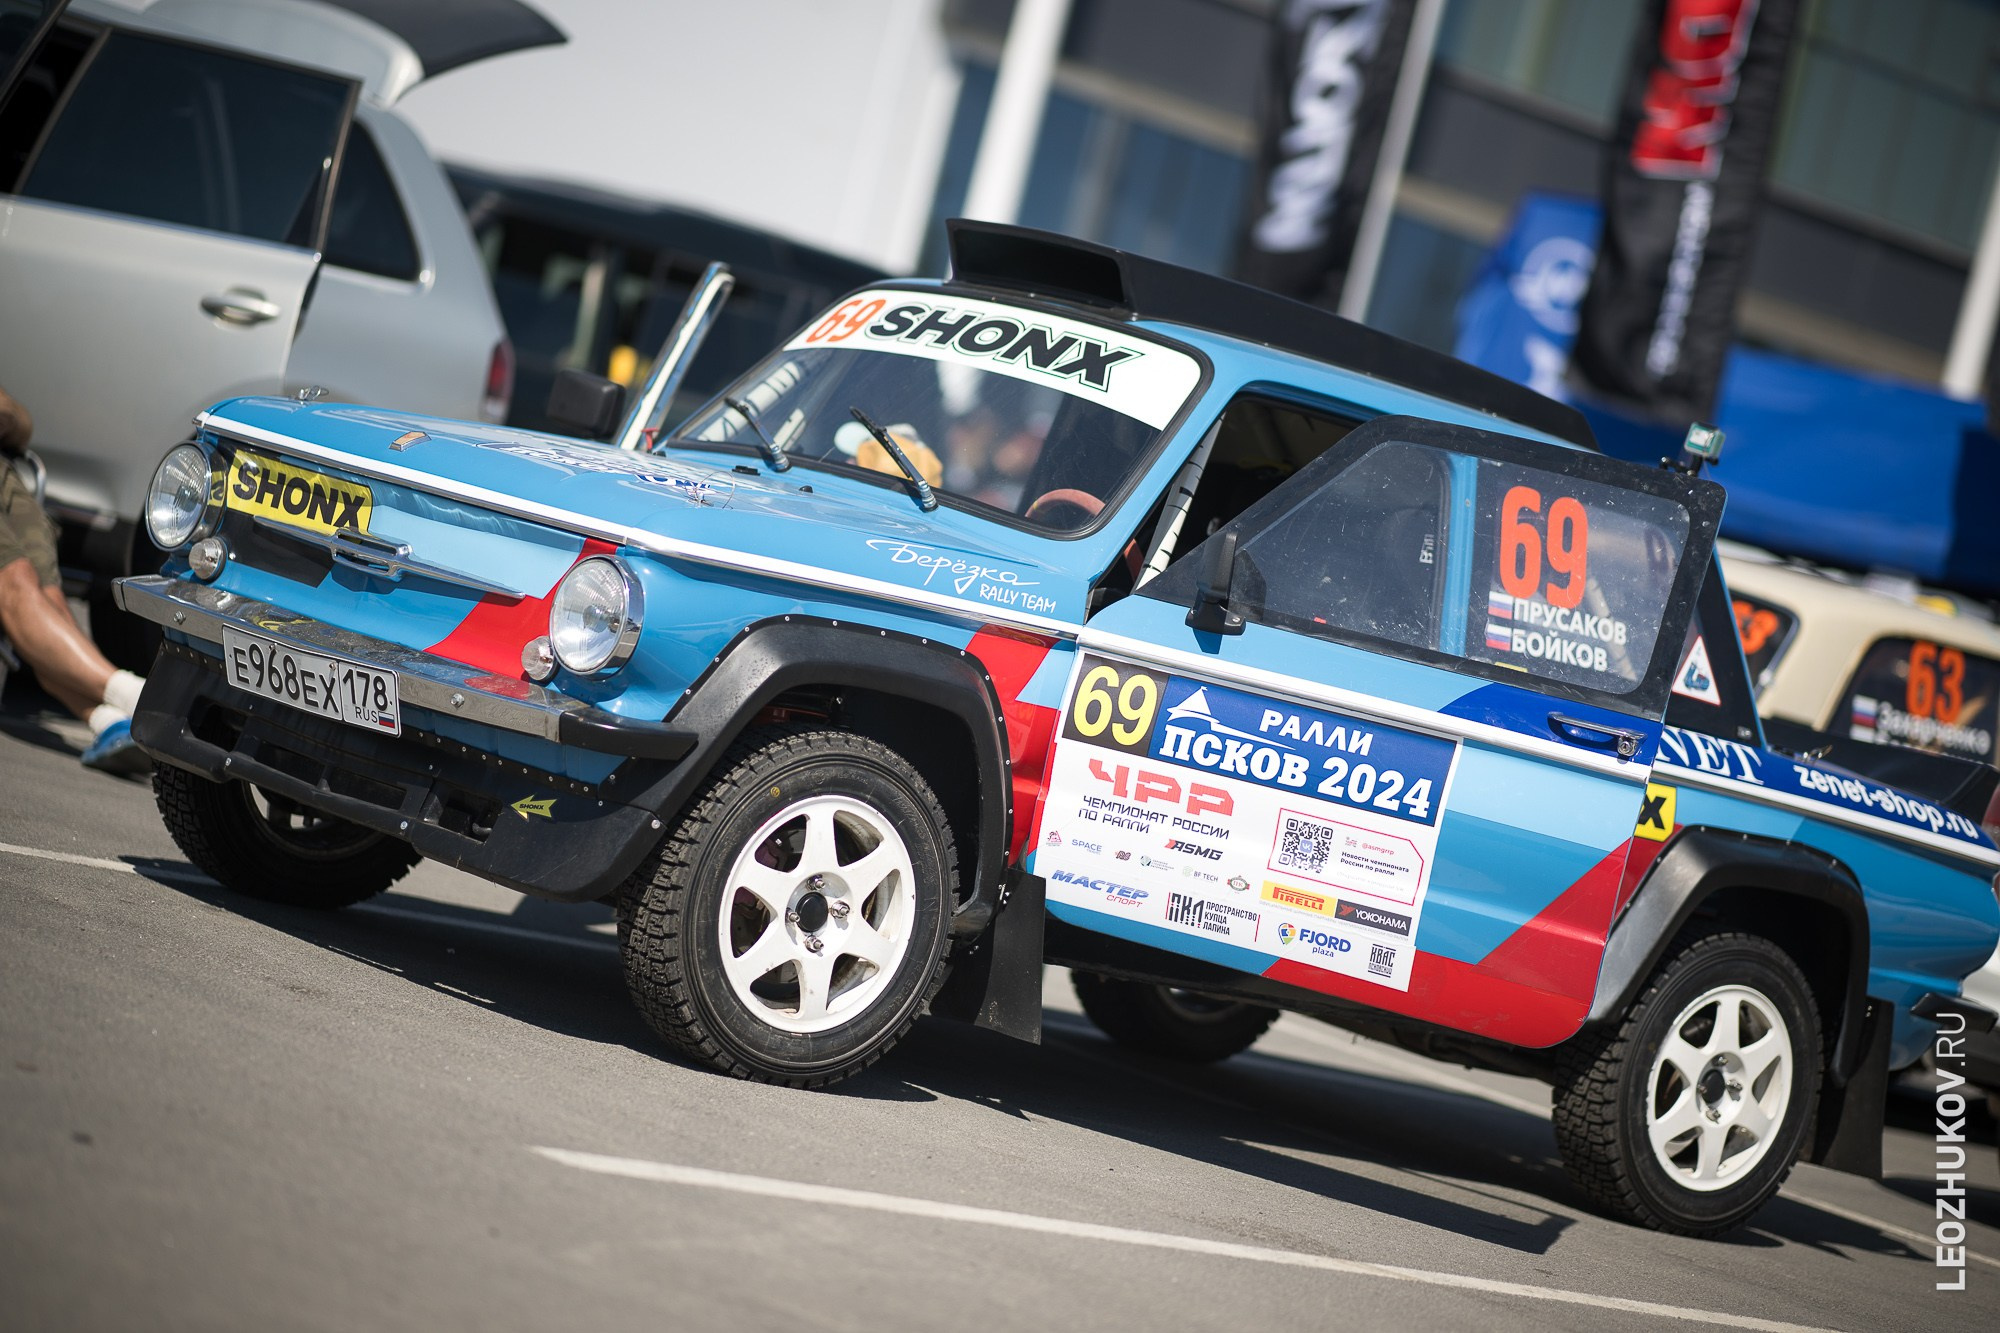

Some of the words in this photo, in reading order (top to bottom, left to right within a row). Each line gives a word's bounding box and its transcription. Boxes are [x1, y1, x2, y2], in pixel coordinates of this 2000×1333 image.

[806, 299, 887, 343] 69
[866, 303, 1143, 391] SHONX
[232, 462, 366, 529] SHONX
[1500, 486, 1588, 609] 69
[866, 539, 1041, 594] Берёзка
[979, 583, 1020, 605] RALLY
[1021, 592, 1057, 613] TEAM
[1513, 598, 1627, 646] ПРУСАКОВ
[1512, 629, 1608, 672] БОЙКОВ
[342, 668, 388, 711] 178
[1907, 640, 1965, 724] 63
[355, 706, 378, 724] RUS
[1073, 665, 1158, 746] 69
[1259, 708, 1373, 757] РАЛЛИ
[1159, 724, 1310, 788] ПСКОВ
[1317, 757, 1433, 818] 2024
[1088, 758, 1235, 817] ЧРР
[1792, 764, 1980, 839] zenet-shop.ru
[1079, 808, 1098, 822] ПО
[1102, 813, 1150, 834] РАЛЛИ
[1083, 795, 1168, 825] ЧЕМПИОНАТ
[1172, 816, 1230, 840] РОССИИ
[1072, 839, 1102, 852] SPACE
[1172, 840, 1223, 861] ASMG
[1340, 858, 1364, 870] России
[1374, 867, 1395, 877] ралли
[1341, 851, 1369, 863] Новости
[1369, 859, 1410, 873] чемпионата
[1051, 869, 1150, 900] МАСТЕР
[1202, 873, 1219, 883] TECH
[1106, 894, 1143, 908] СПОРТ
[1205, 901, 1257, 922] ПРОСТРАНСТВО
[1272, 886, 1325, 911] PIRELLI
[1202, 921, 1230, 935] ЛАПИНА
[1204, 911, 1227, 925] КУПЦА
[1355, 909, 1407, 931] YOKOHAMA
[1299, 928, 1352, 953] FJORD
[1312, 946, 1334, 958] plaza
[1370, 946, 1395, 967] КВАС
